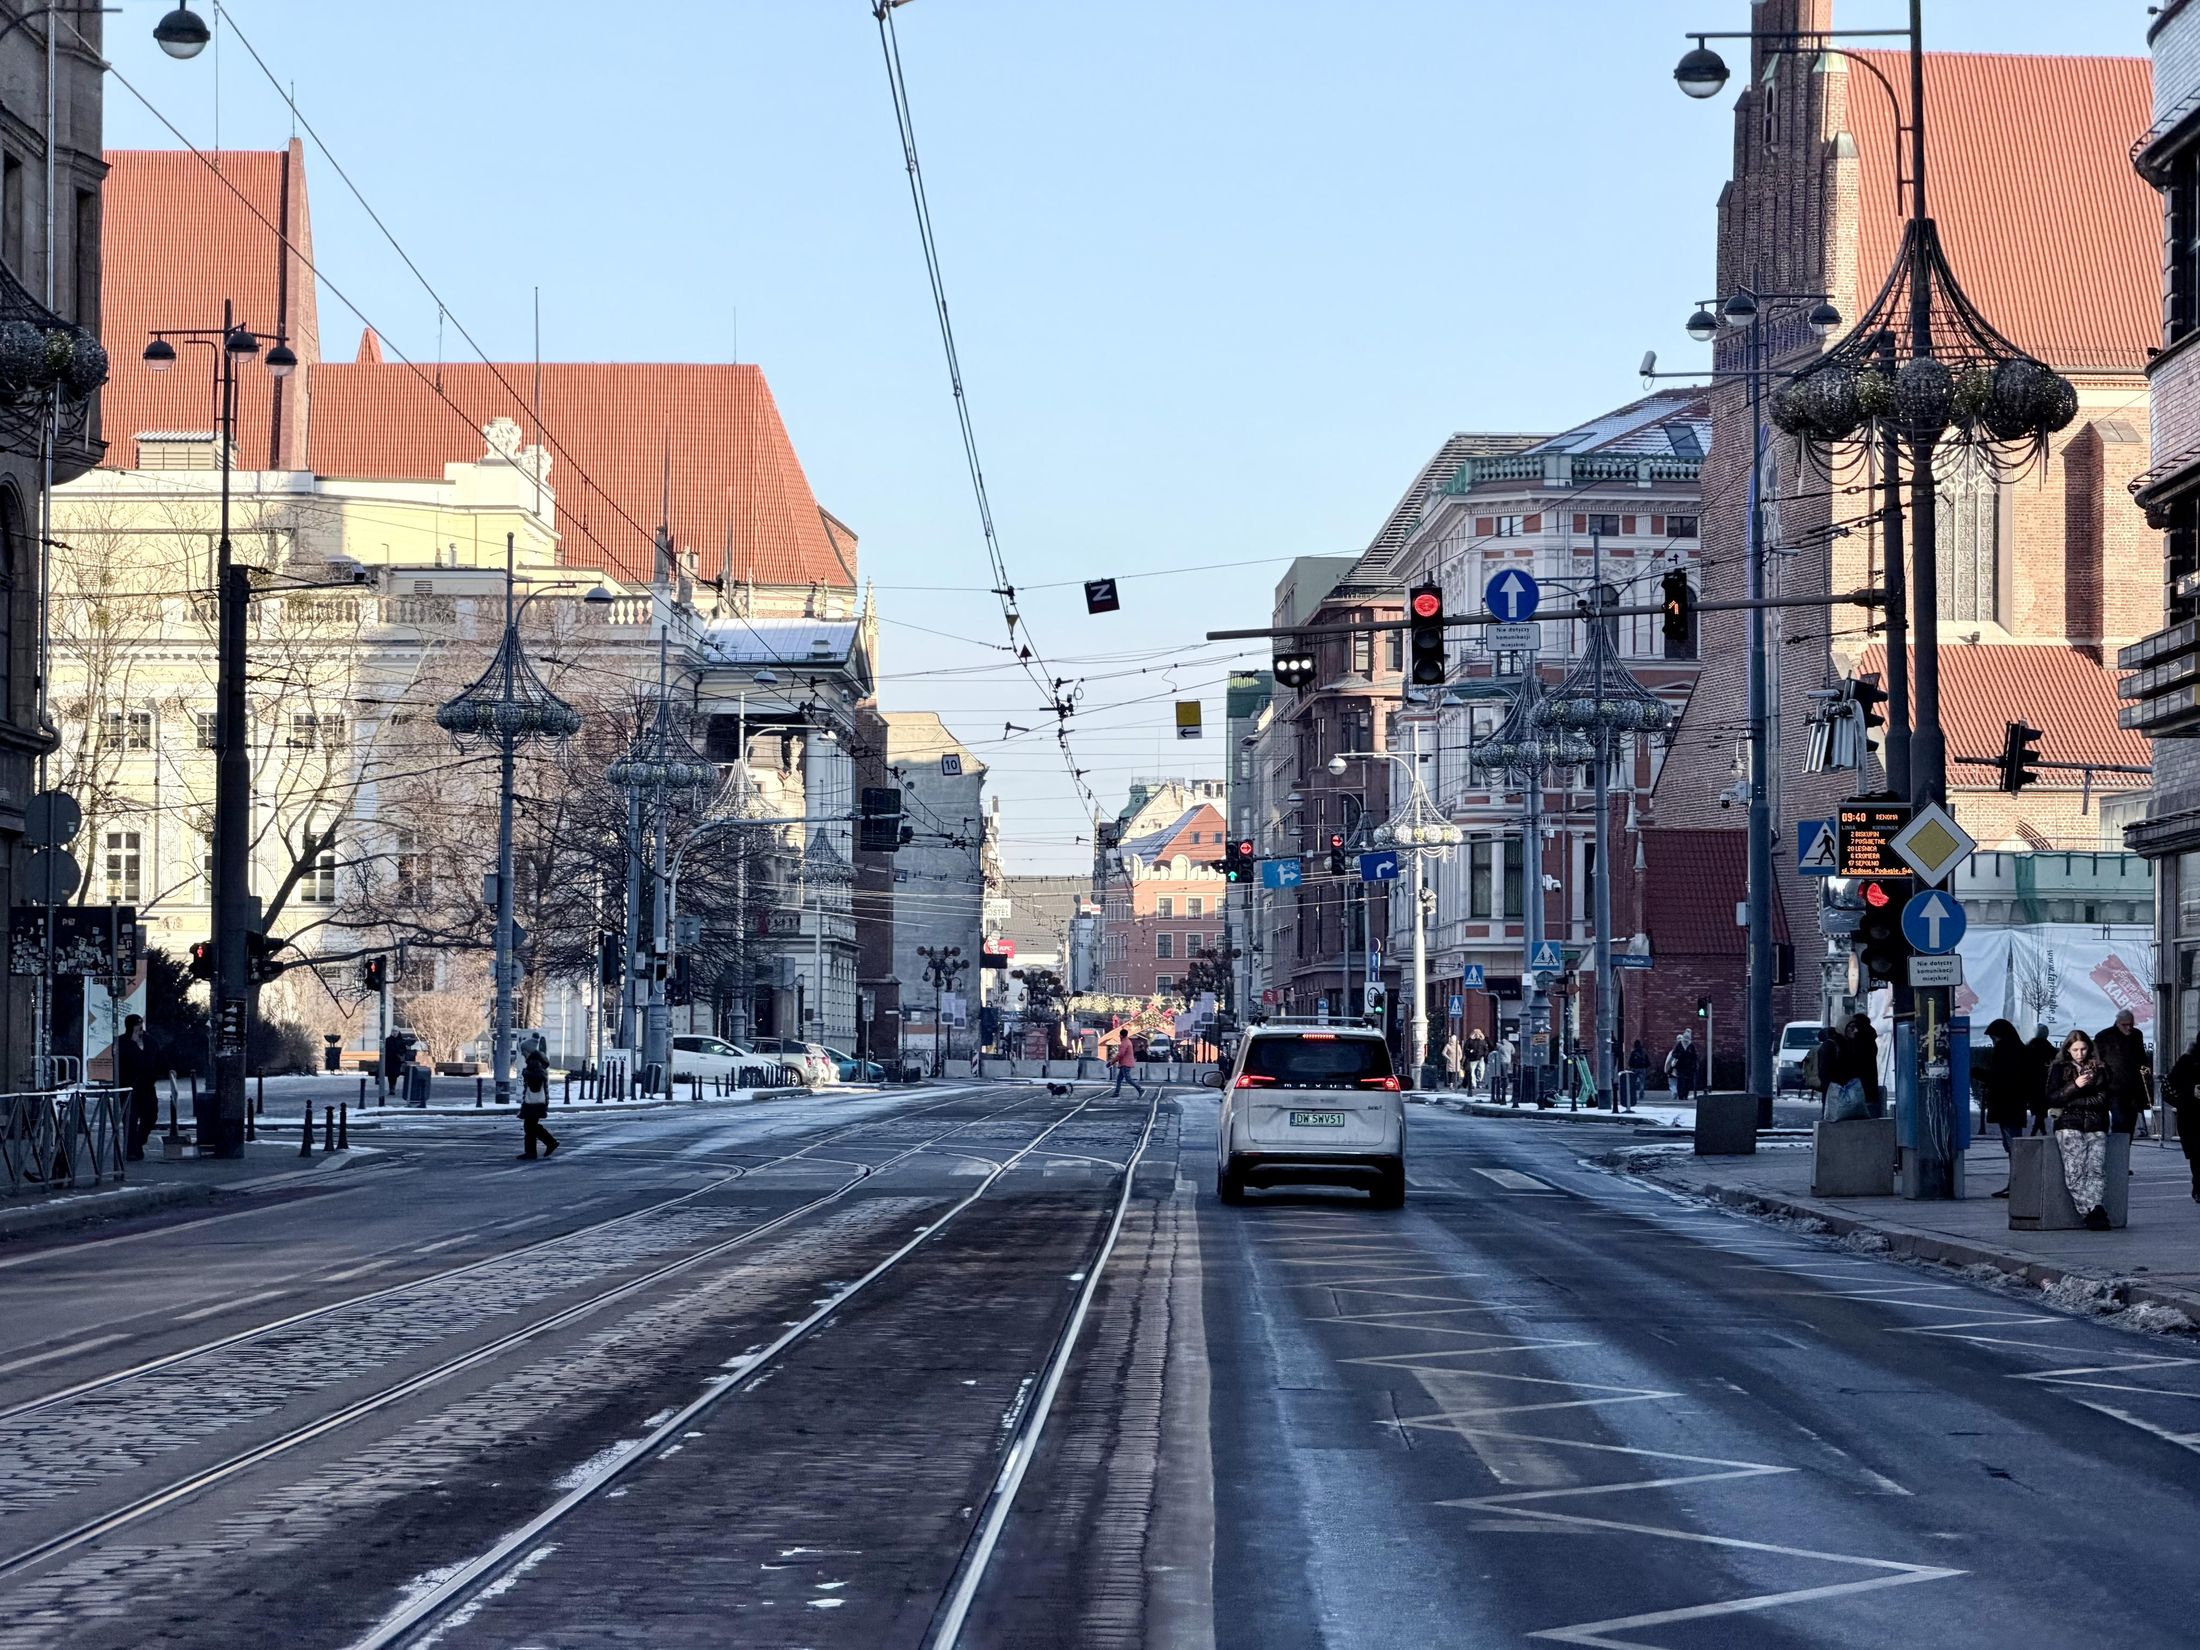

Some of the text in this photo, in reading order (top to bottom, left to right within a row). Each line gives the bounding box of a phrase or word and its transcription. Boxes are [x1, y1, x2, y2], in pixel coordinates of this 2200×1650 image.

[946, 760, 957, 770] 10
[1841, 812, 1867, 823] 09:40
[1296, 1114, 1341, 1124] DW 5WV51
